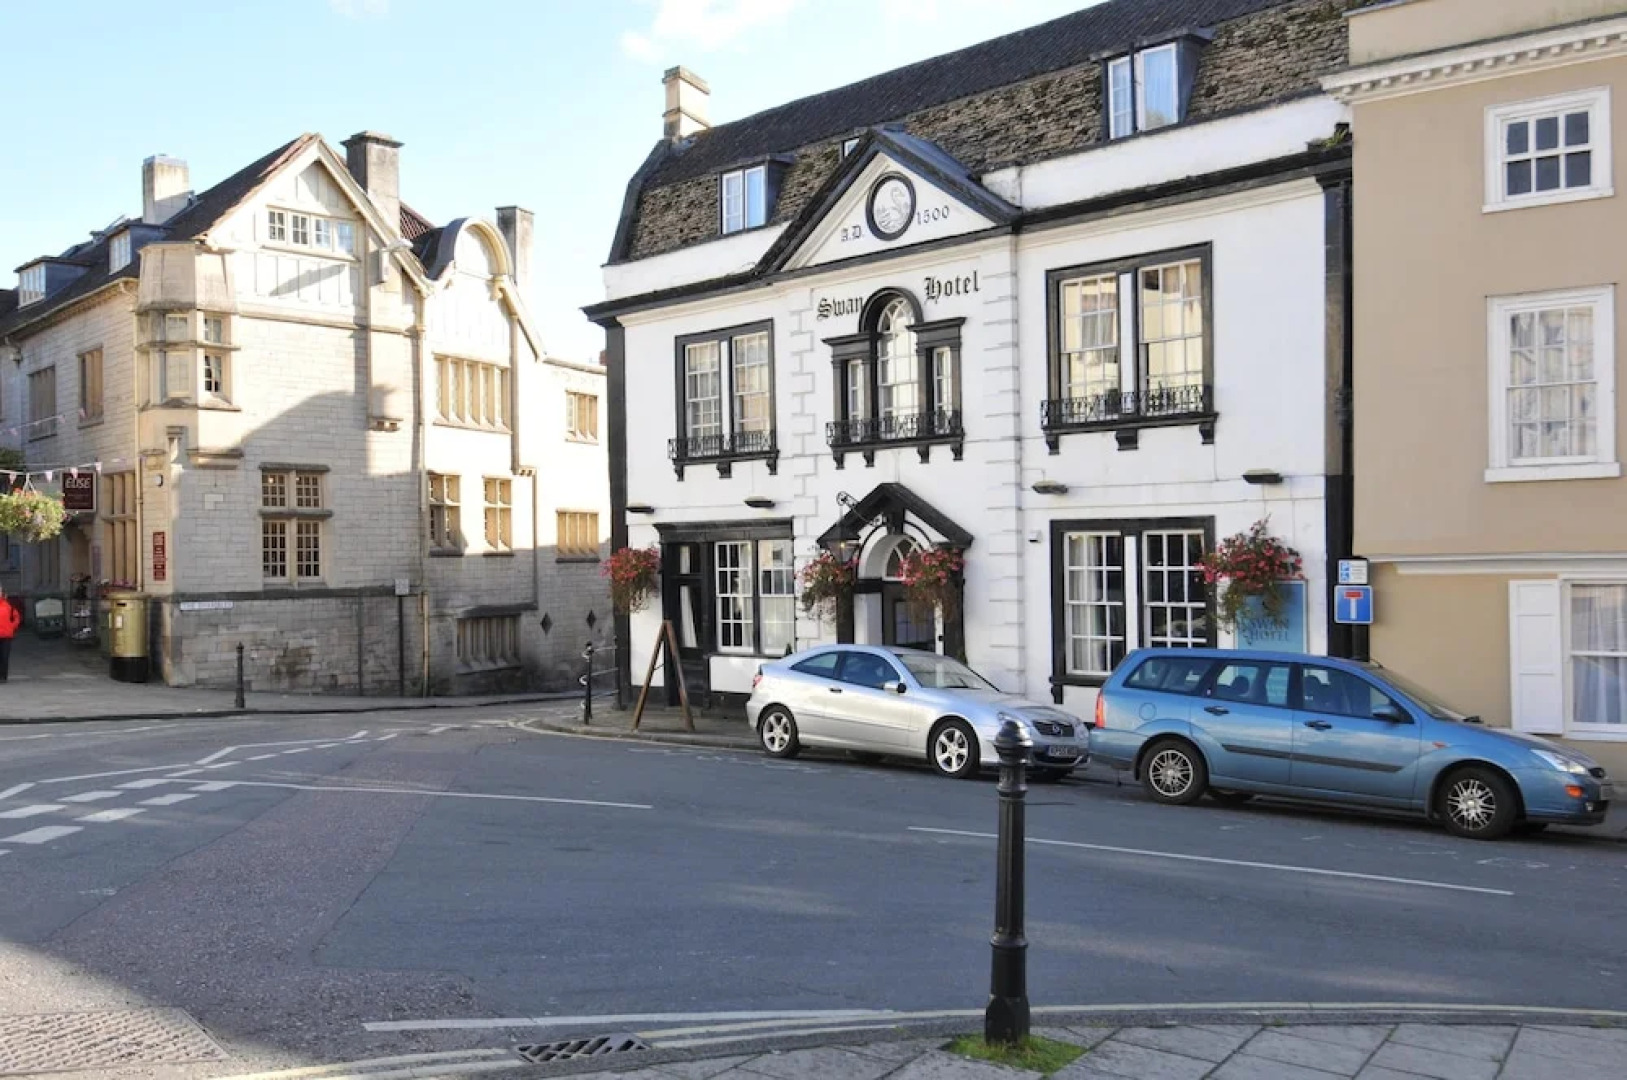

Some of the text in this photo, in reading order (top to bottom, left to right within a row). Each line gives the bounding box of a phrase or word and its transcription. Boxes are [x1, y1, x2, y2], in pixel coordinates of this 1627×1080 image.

[917, 205, 949, 225] 1500
[817, 270, 981, 321] Swan Hotel
